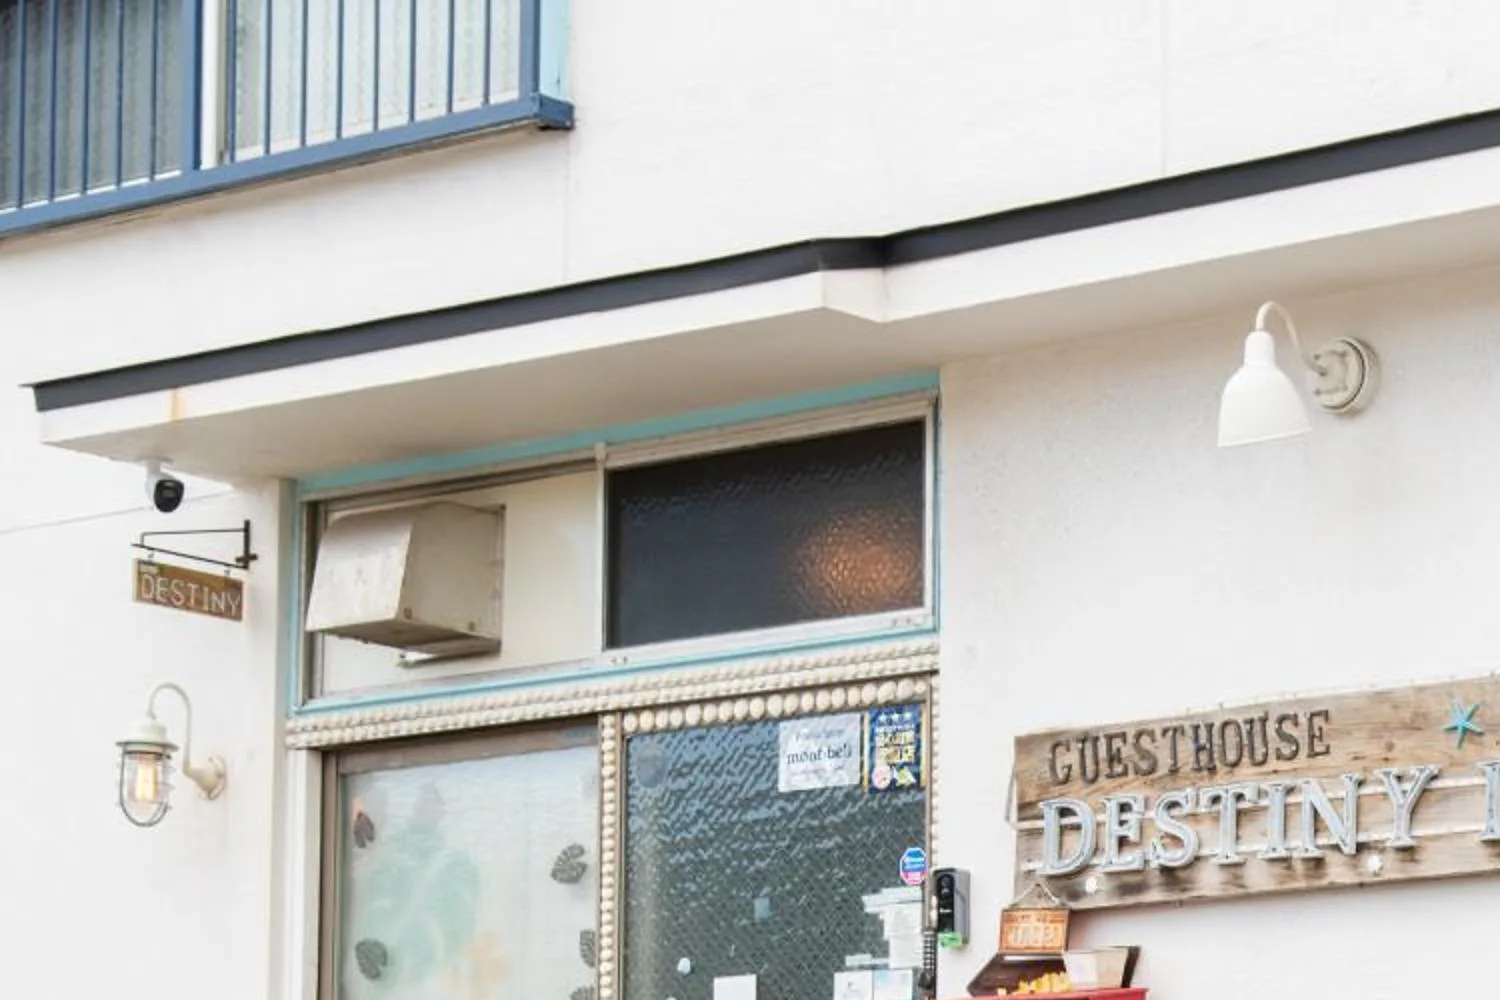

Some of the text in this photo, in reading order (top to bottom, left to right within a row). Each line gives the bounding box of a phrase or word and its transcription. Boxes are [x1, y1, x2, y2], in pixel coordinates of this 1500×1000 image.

[141, 574, 240, 616] DESTINY
[1050, 709, 1331, 785] GUESTHOUSE
[1037, 766, 1442, 876] DESTINY
